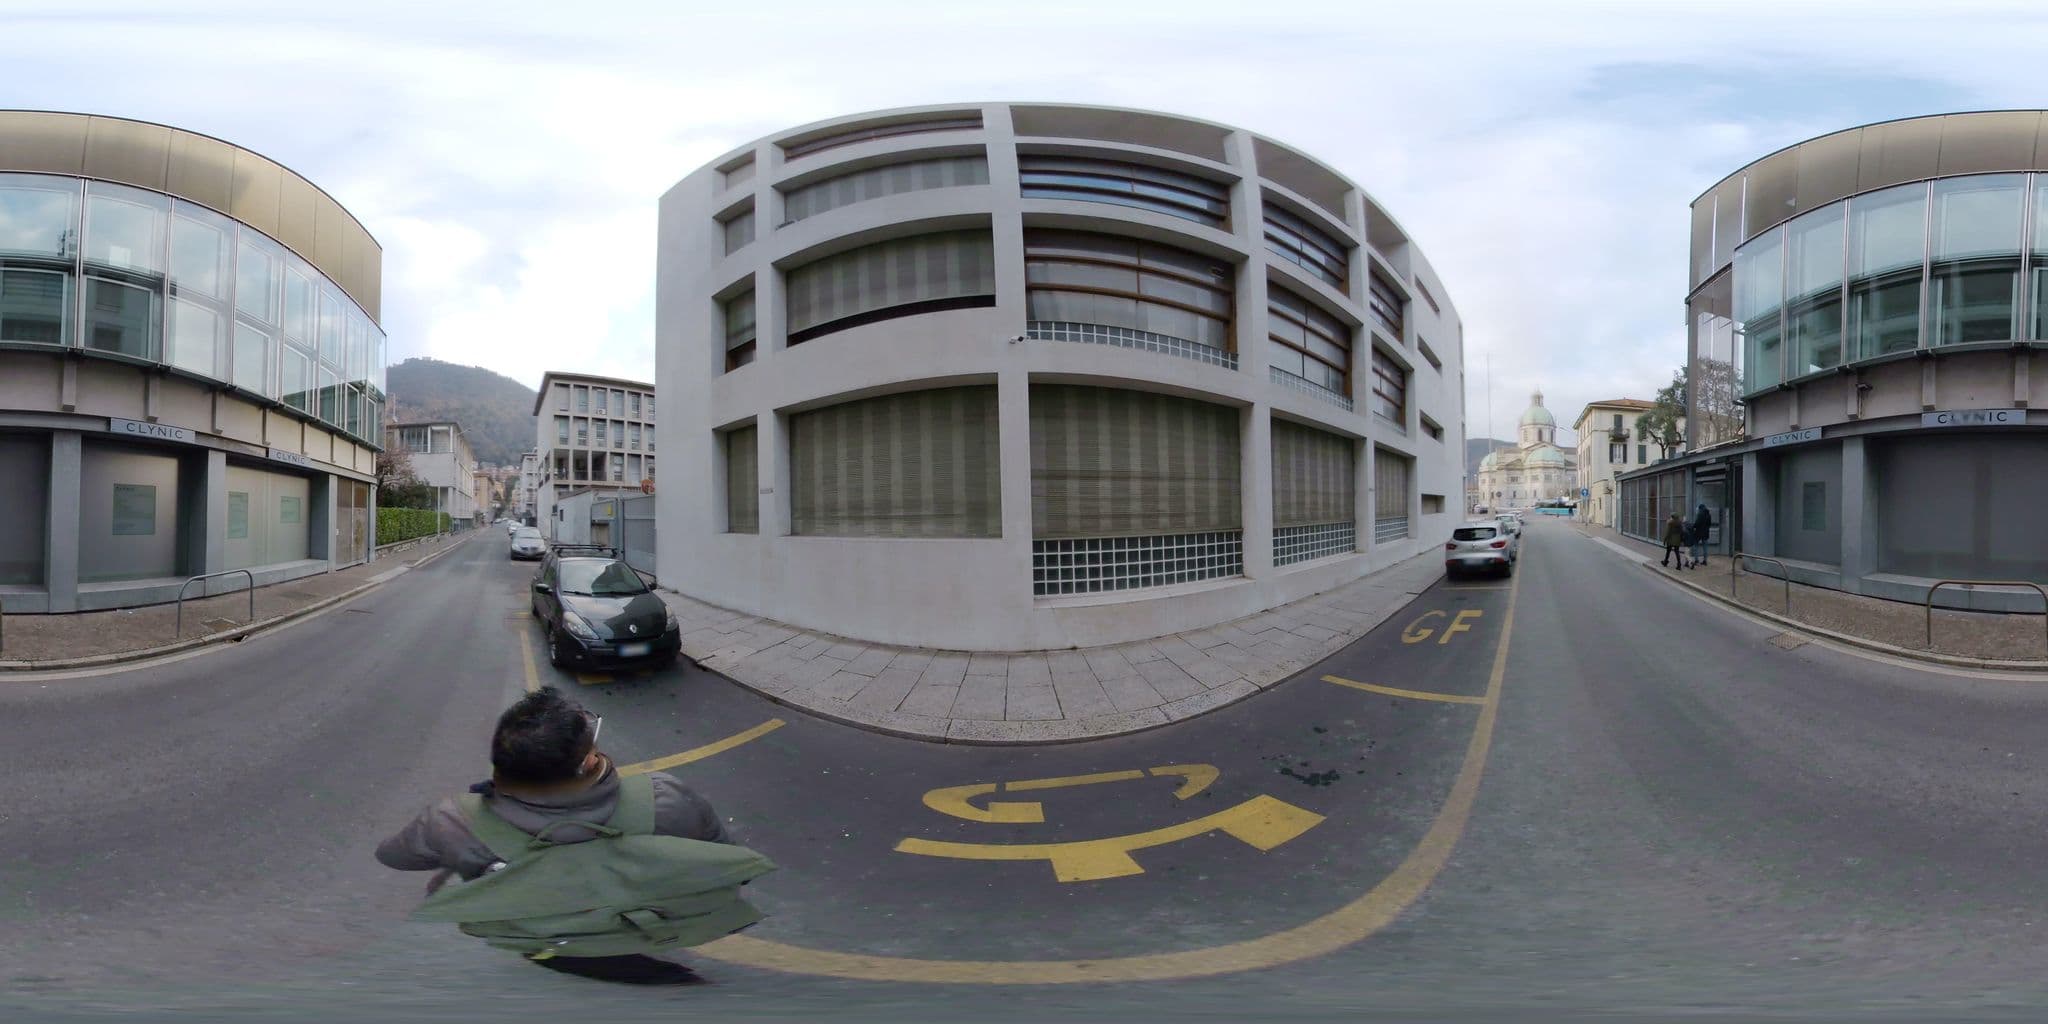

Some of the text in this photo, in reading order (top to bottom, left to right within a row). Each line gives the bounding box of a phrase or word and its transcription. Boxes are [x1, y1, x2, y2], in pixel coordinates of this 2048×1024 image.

[126, 422, 183, 439] CLYNIC
[1771, 430, 1811, 445] CLYNIC
[276, 451, 305, 465] CLYNIC
[1401, 609, 1483, 644] GF
